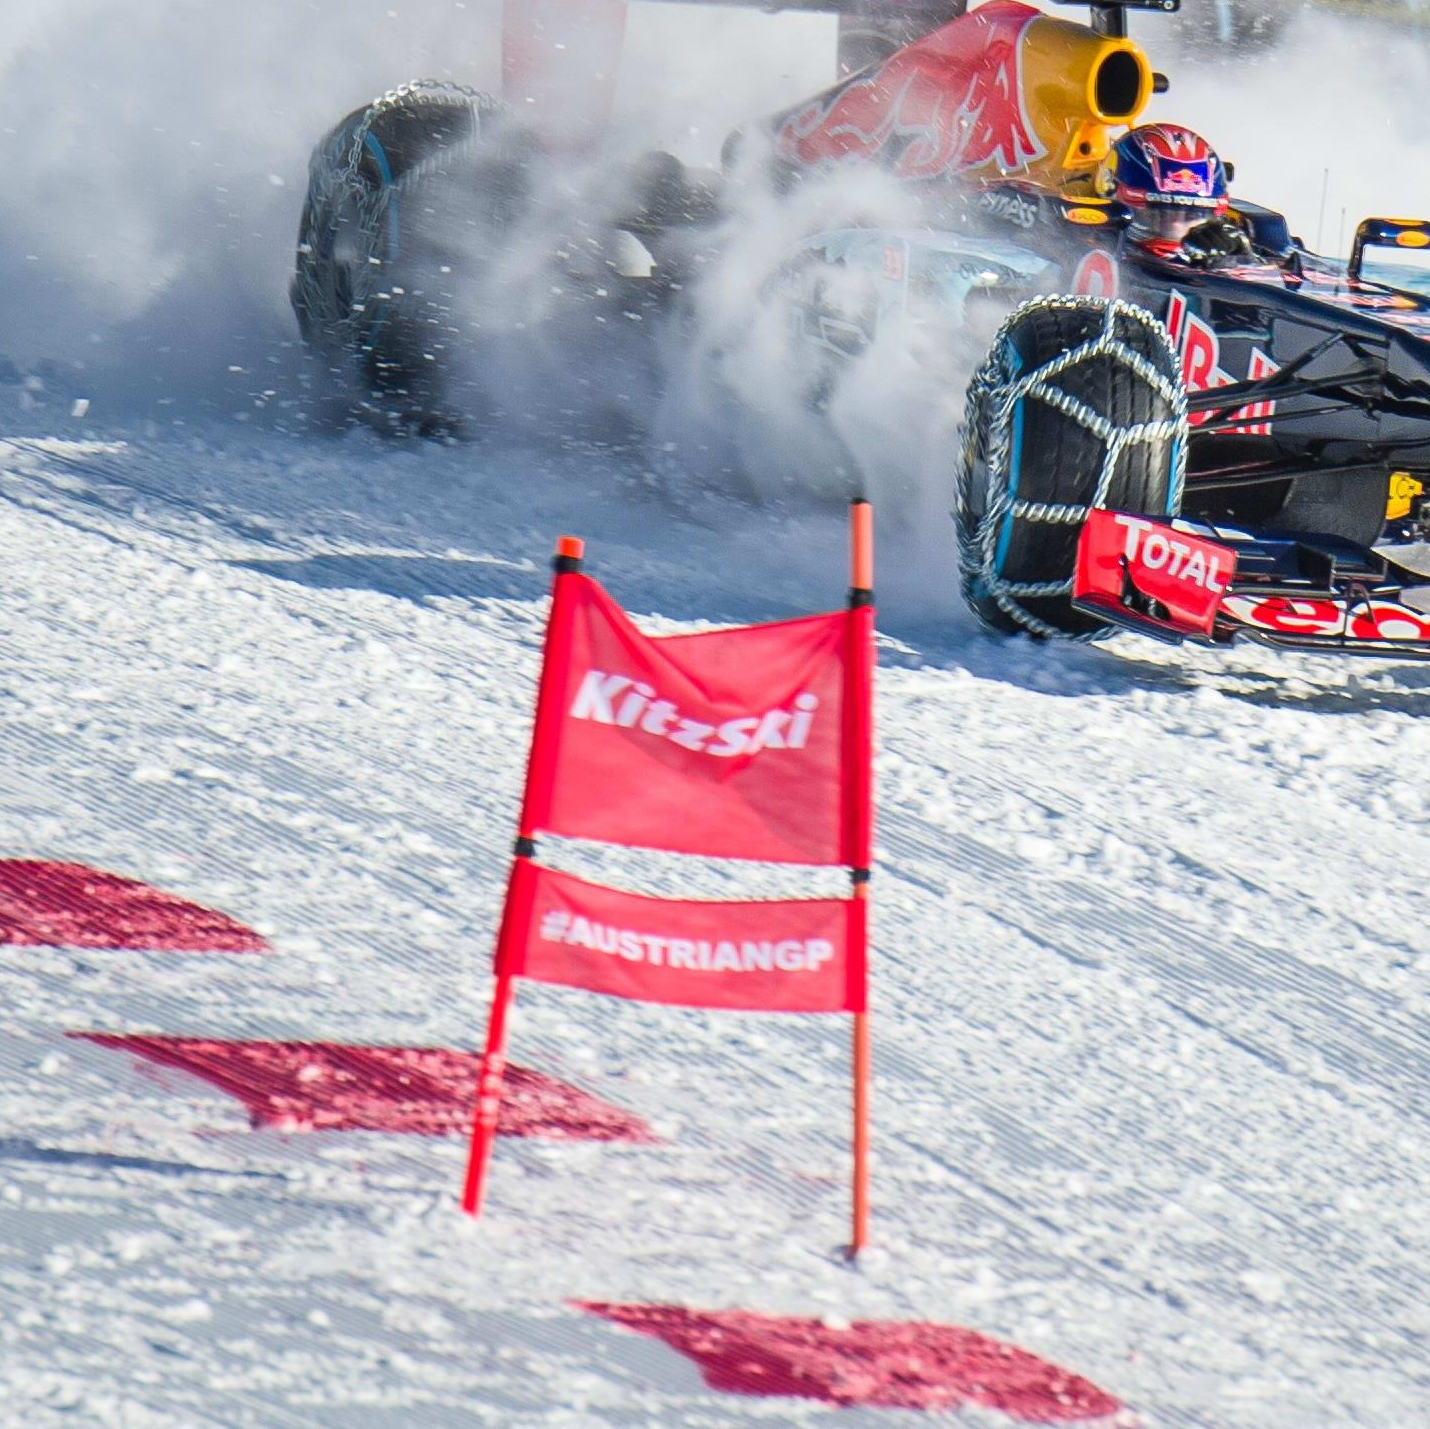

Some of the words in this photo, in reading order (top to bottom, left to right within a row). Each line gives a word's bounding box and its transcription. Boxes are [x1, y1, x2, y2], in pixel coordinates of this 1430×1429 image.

[1114, 513, 1224, 594] TOTAL
[569, 669, 819, 757] KitzSki
[539, 911, 833, 972] #AUSTRIANGP
